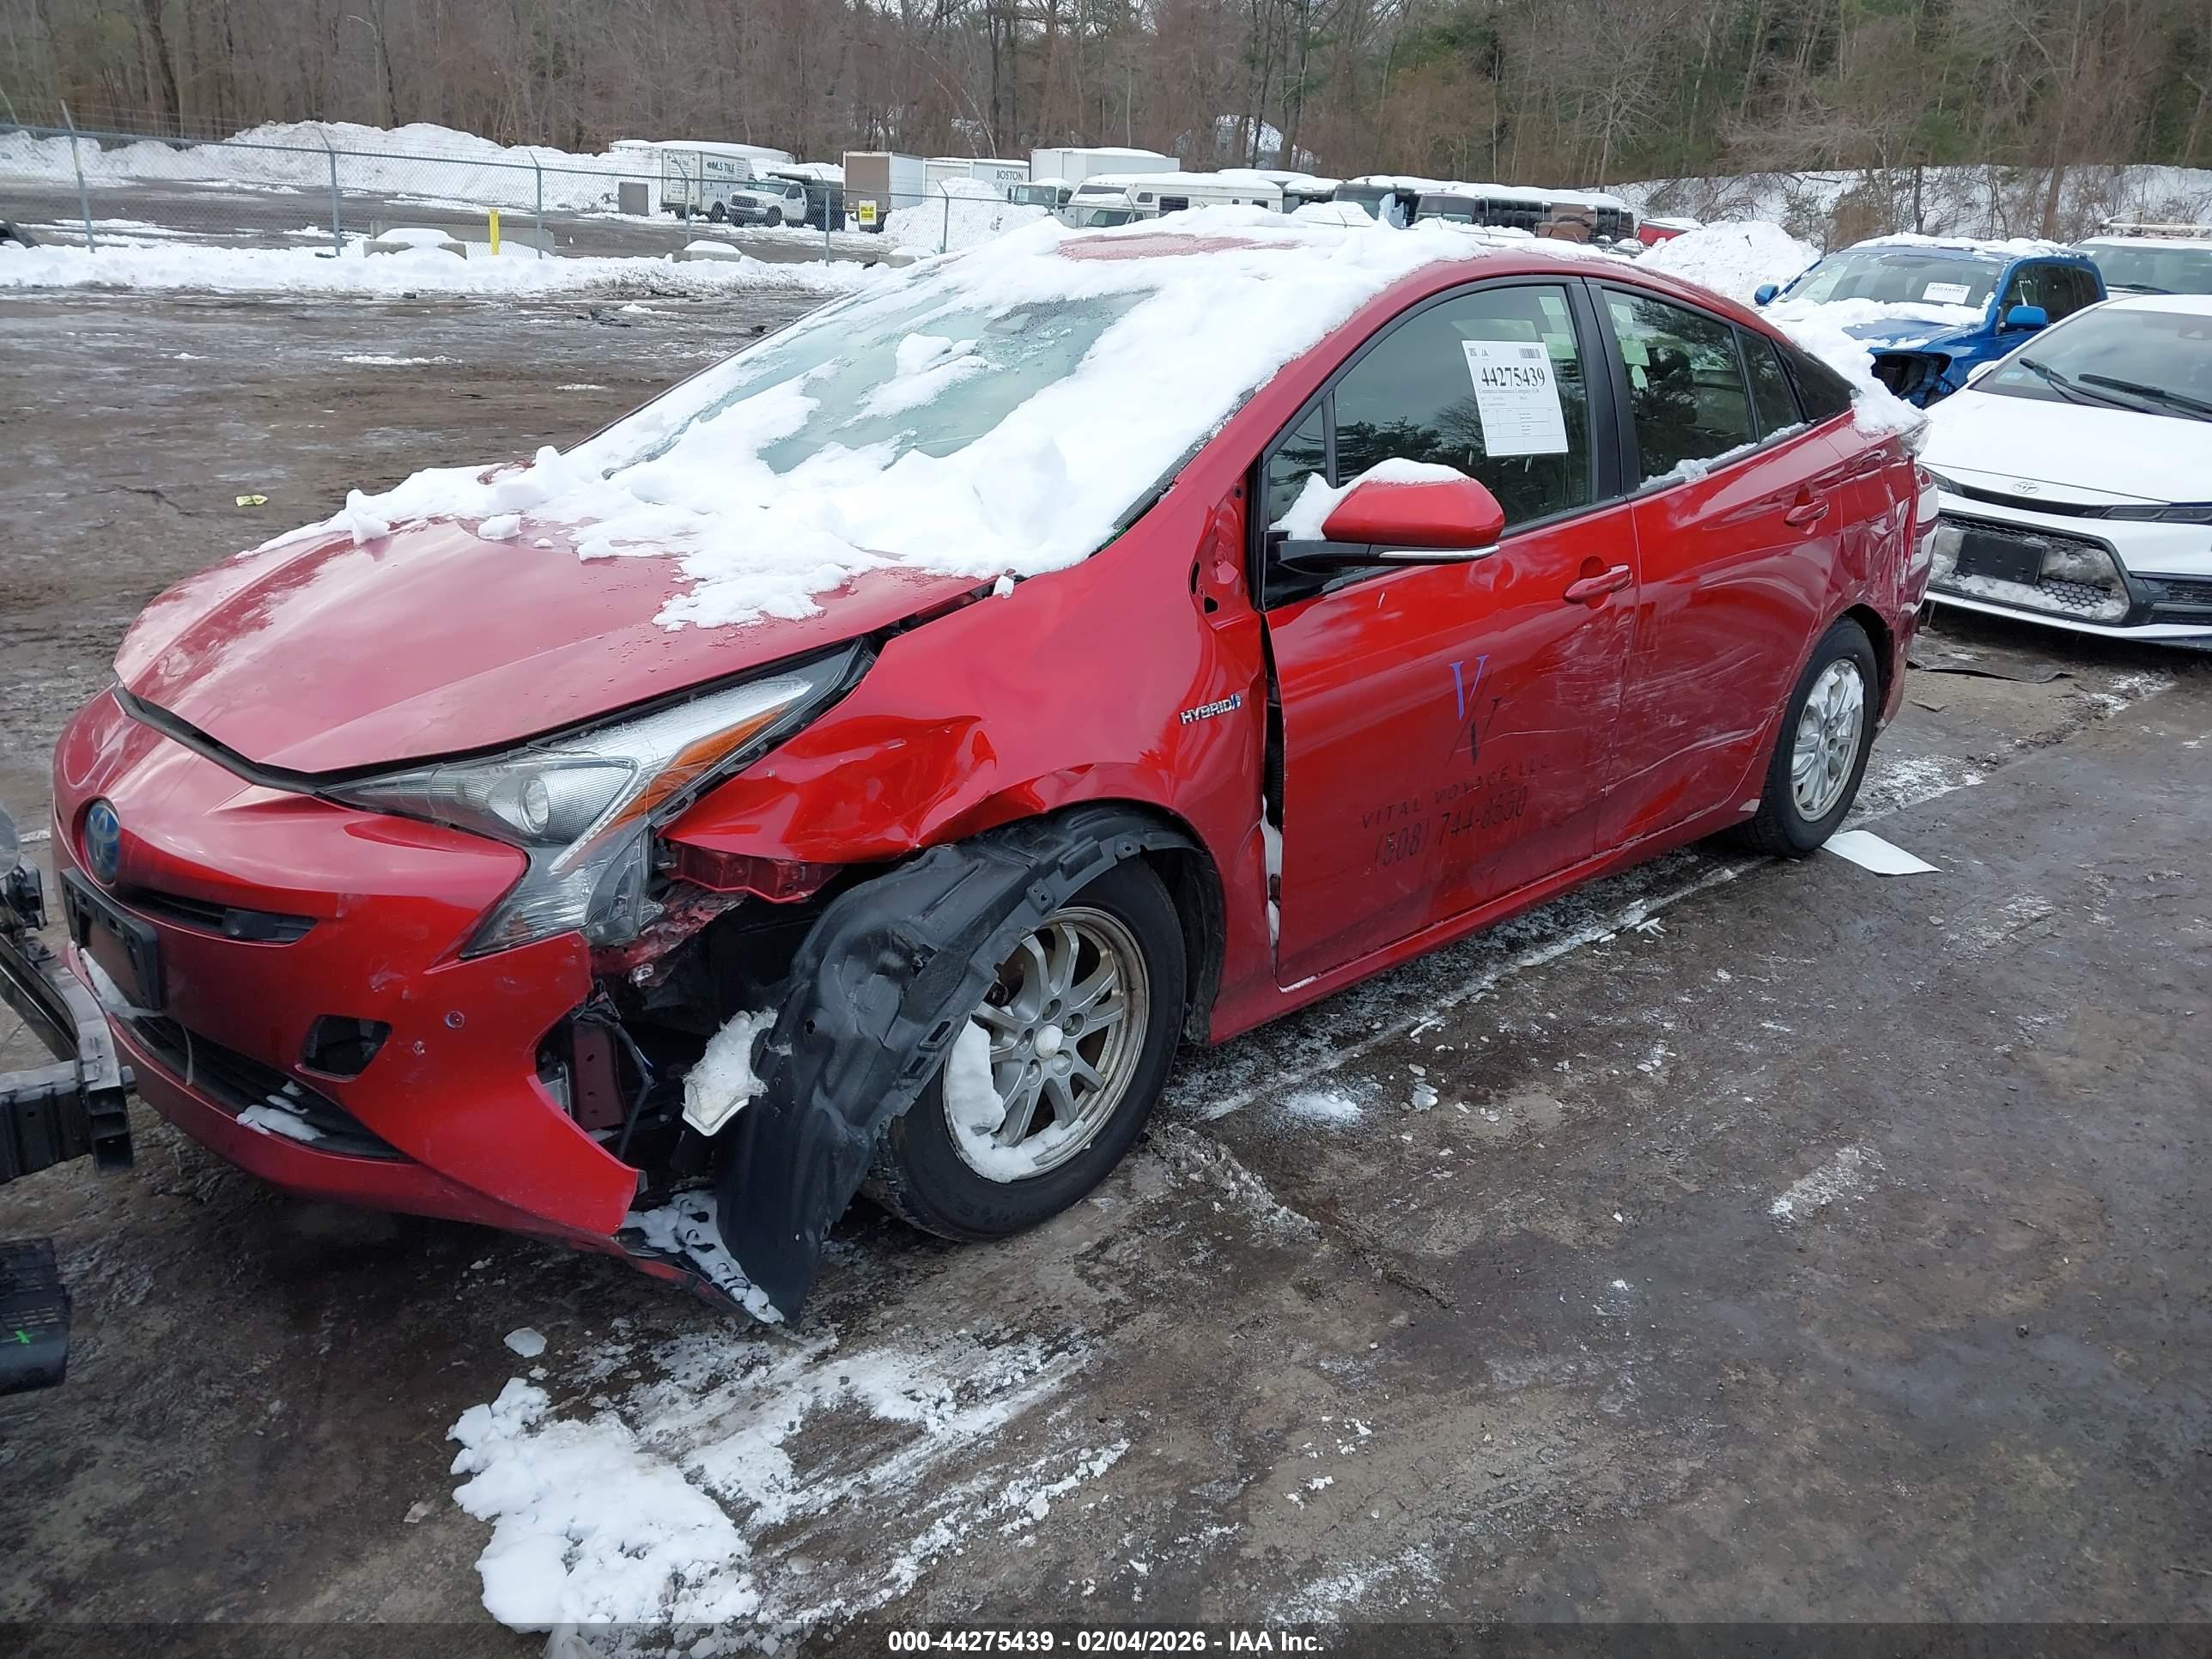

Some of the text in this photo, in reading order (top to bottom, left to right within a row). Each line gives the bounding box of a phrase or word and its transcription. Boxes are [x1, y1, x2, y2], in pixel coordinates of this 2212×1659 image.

[724, 161, 735, 173] TILE
[996, 169, 1024, 181] BOSTON
[1481, 366, 1546, 386] 44275439
[1179, 699, 1232, 725] HYBRID
[1362, 797, 1422, 830] VITAL
[1518, 753, 1552, 777] LLC
